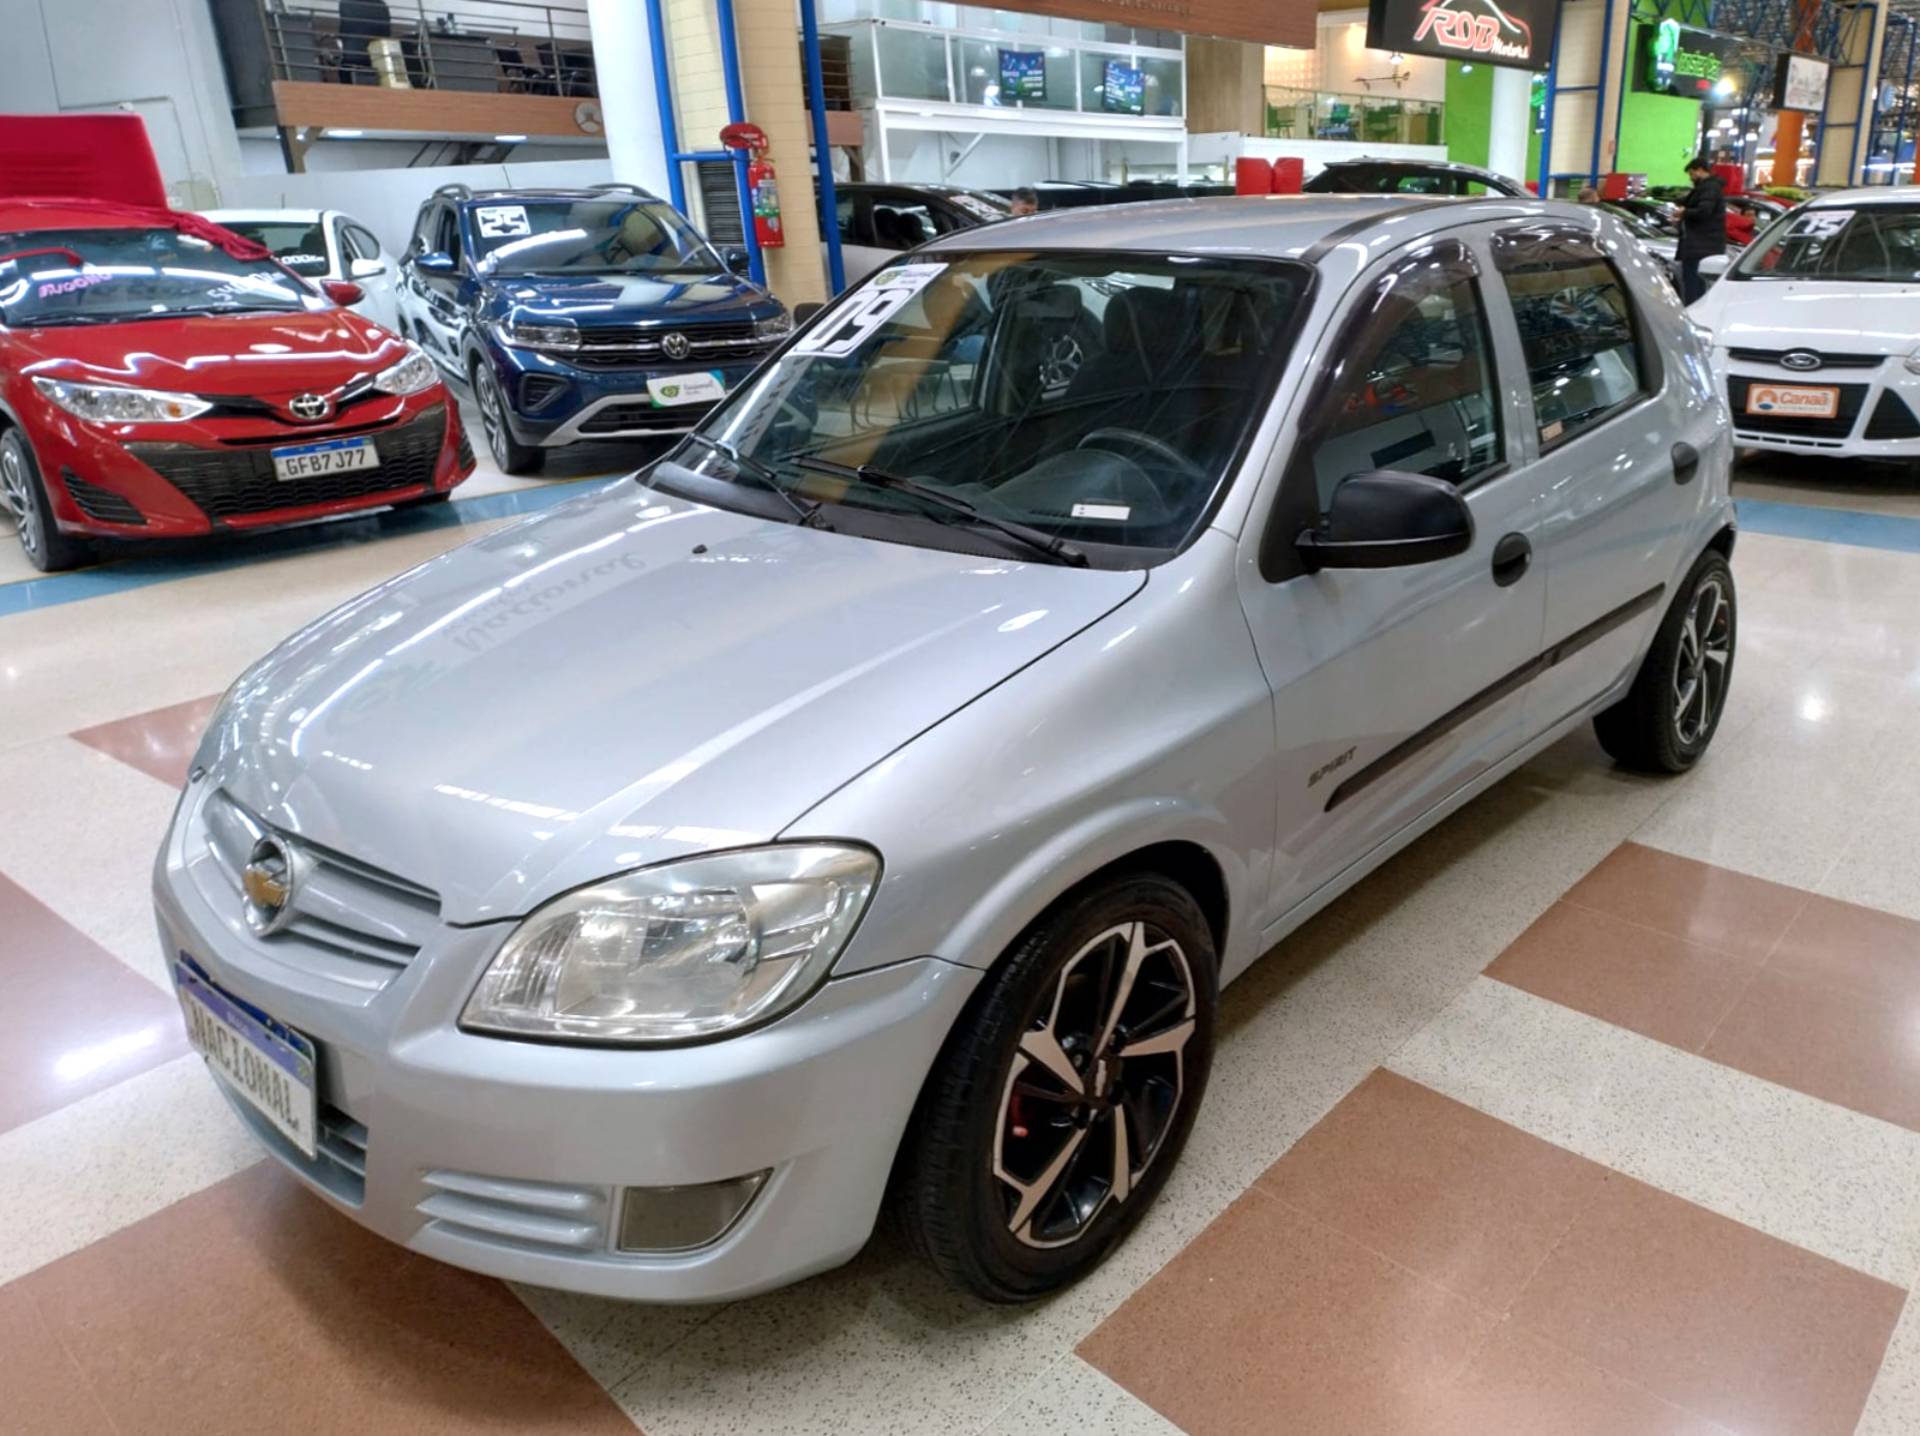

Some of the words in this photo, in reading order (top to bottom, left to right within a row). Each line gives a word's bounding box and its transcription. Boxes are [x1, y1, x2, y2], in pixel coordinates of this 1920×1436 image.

[794, 288, 914, 354] 09
[1307, 745, 1357, 789] SPIRIT
[188, 997, 300, 1132] NACIONAL
